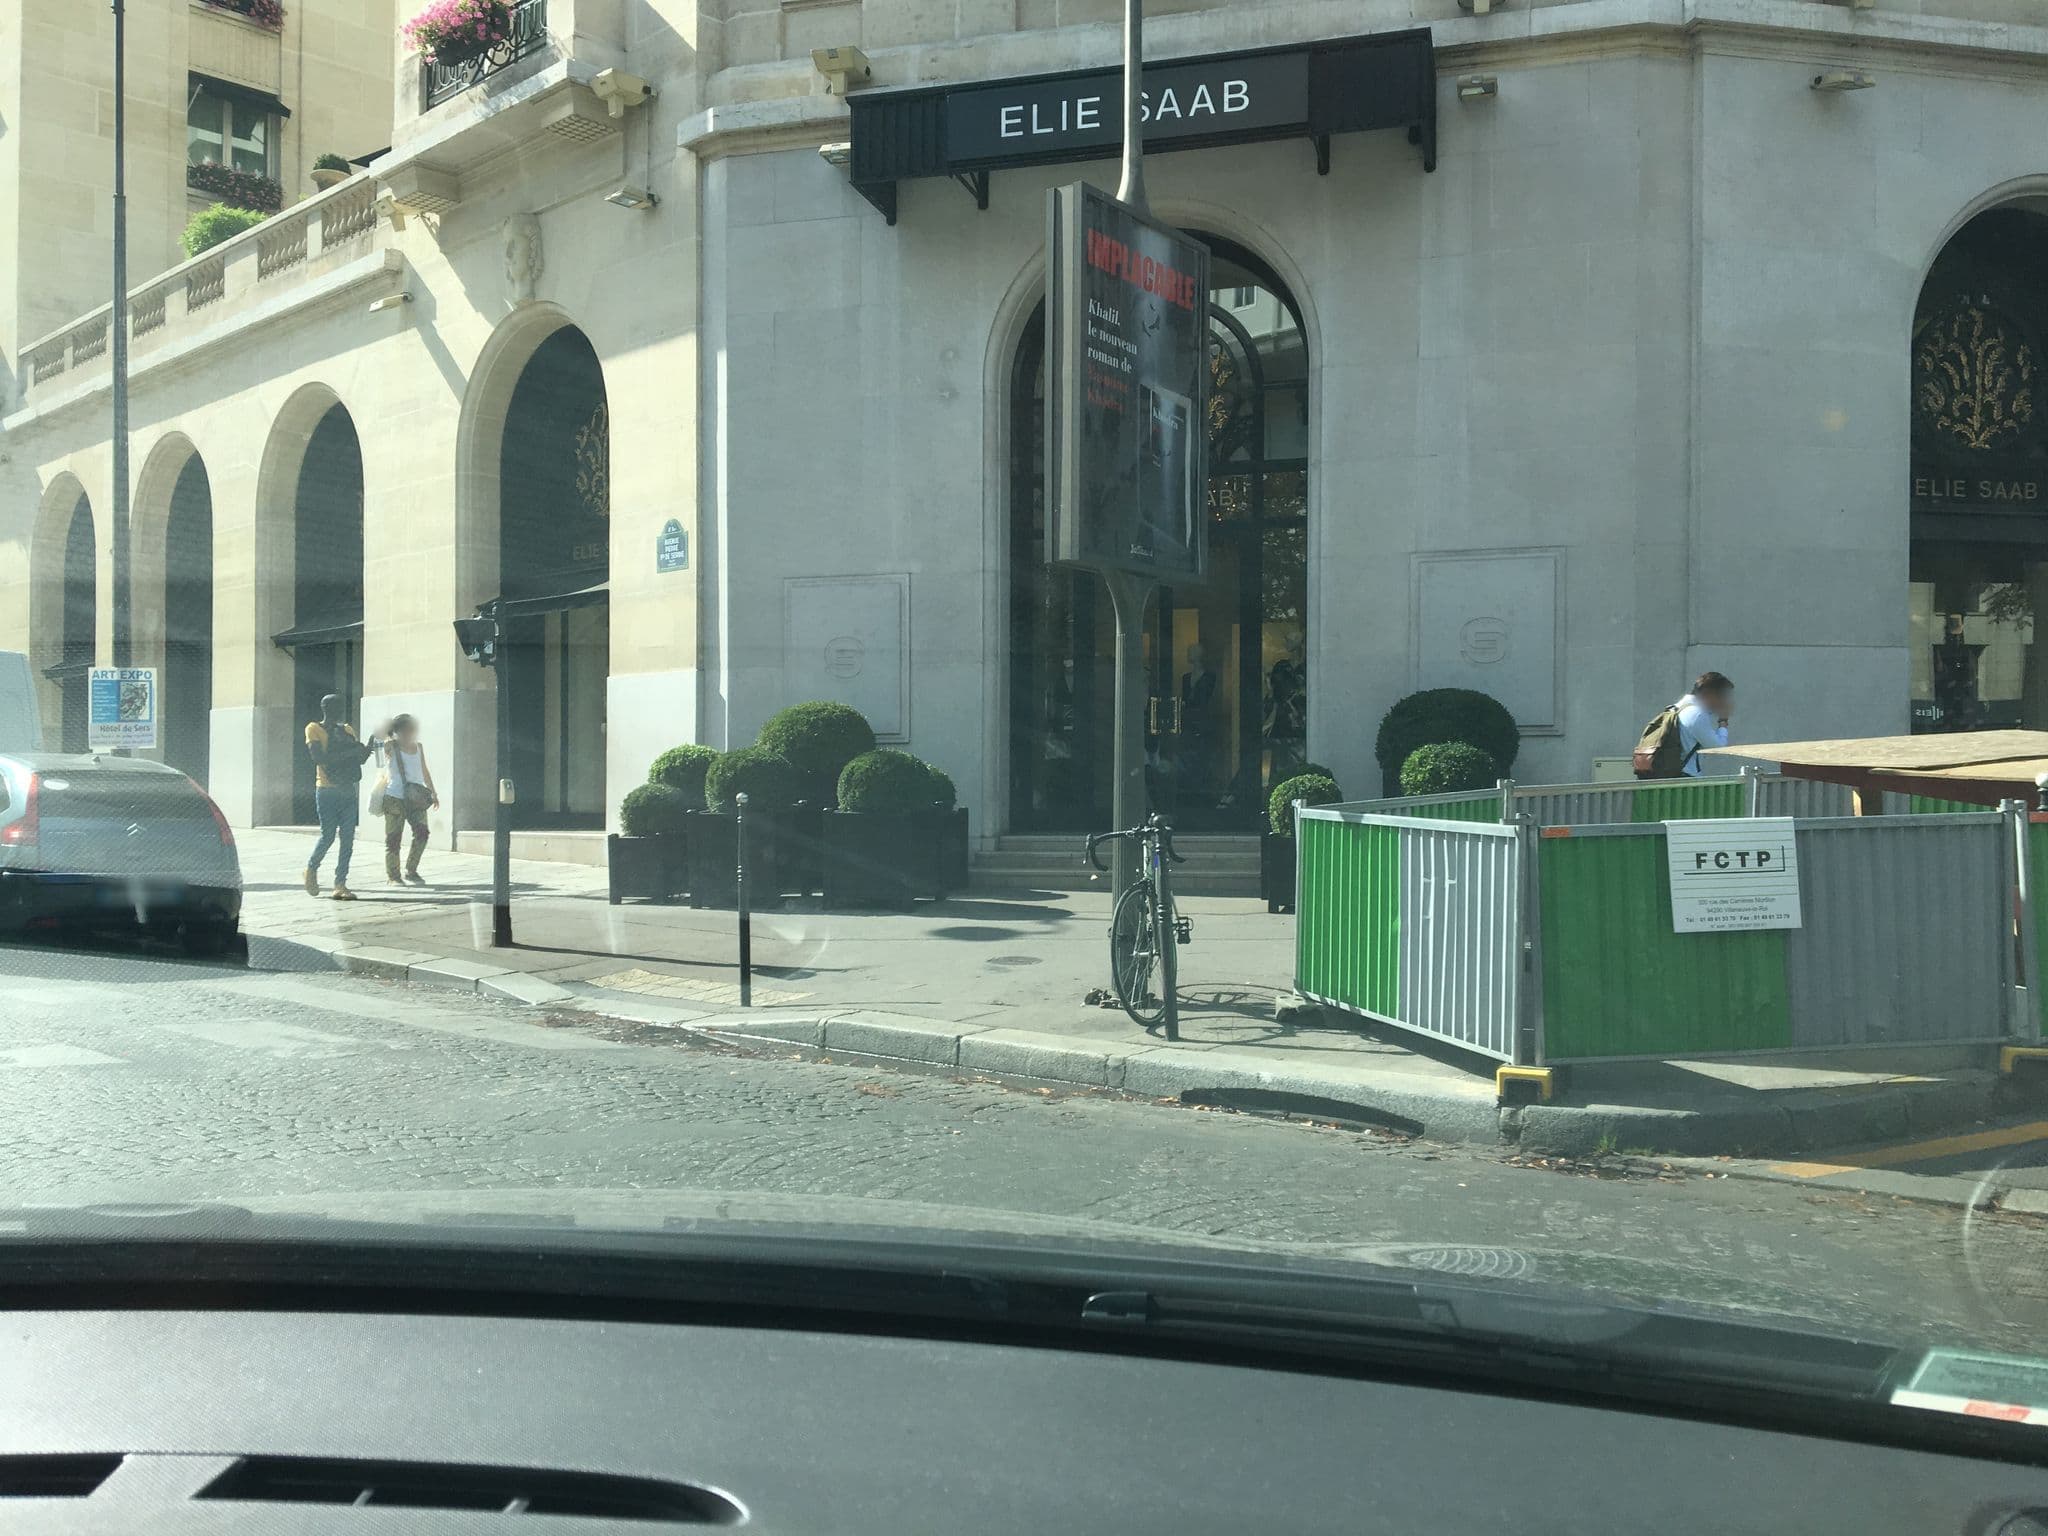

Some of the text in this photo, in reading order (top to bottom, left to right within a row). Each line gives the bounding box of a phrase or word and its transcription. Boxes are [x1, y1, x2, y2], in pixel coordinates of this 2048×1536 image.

[1000, 96, 1101, 138] ELIE
[1087, 228, 1196, 312] IMPLACABLE
[1088, 320, 1138, 356] le nouveau
[1088, 346, 1133, 374] roman de
[1914, 478, 2038, 500] ELIE SAAB
[92, 671, 152, 679] ART EXPO
[1695, 851, 1771, 869] FCTP
